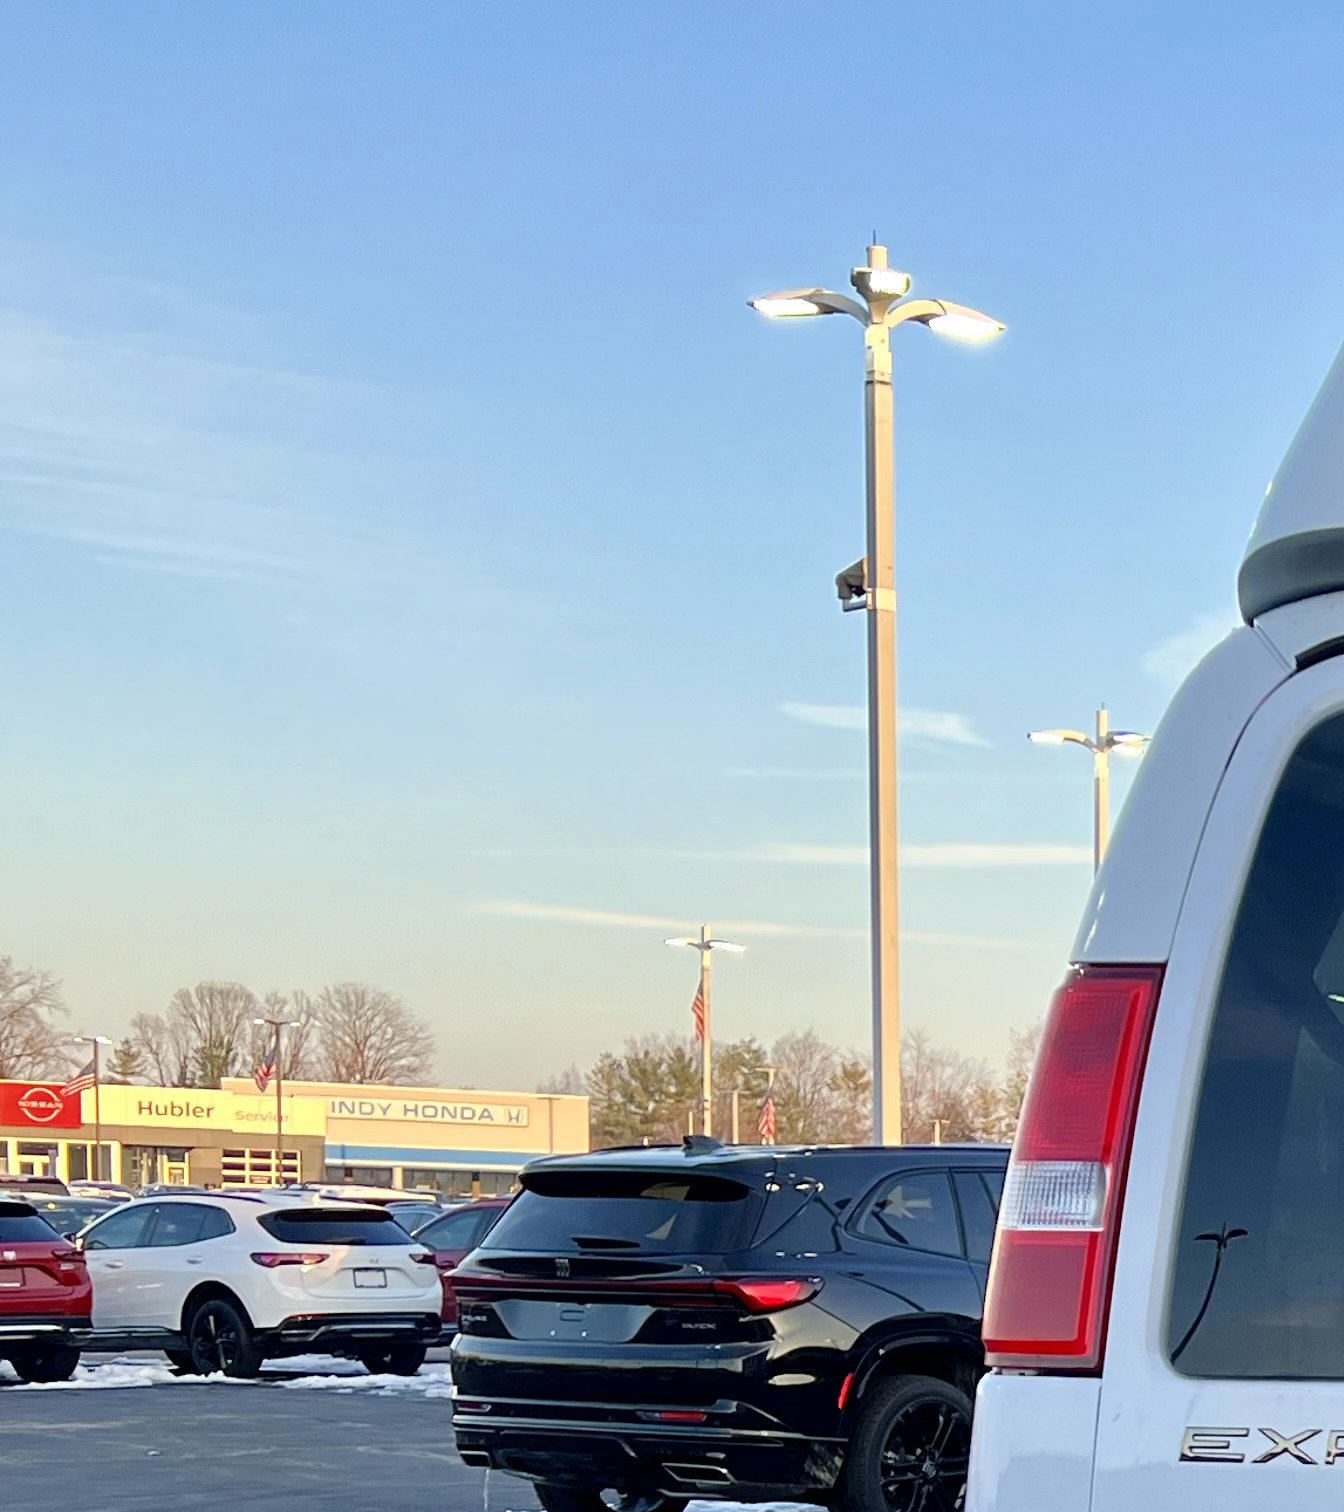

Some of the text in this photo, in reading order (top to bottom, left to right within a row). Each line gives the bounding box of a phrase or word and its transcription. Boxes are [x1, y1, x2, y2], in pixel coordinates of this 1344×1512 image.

[18, 1100, 63, 1109] NISSAN
[137, 1101, 215, 1118] Hubler
[330, 1100, 392, 1116] INDY
[403, 1103, 494, 1122] HONDA
